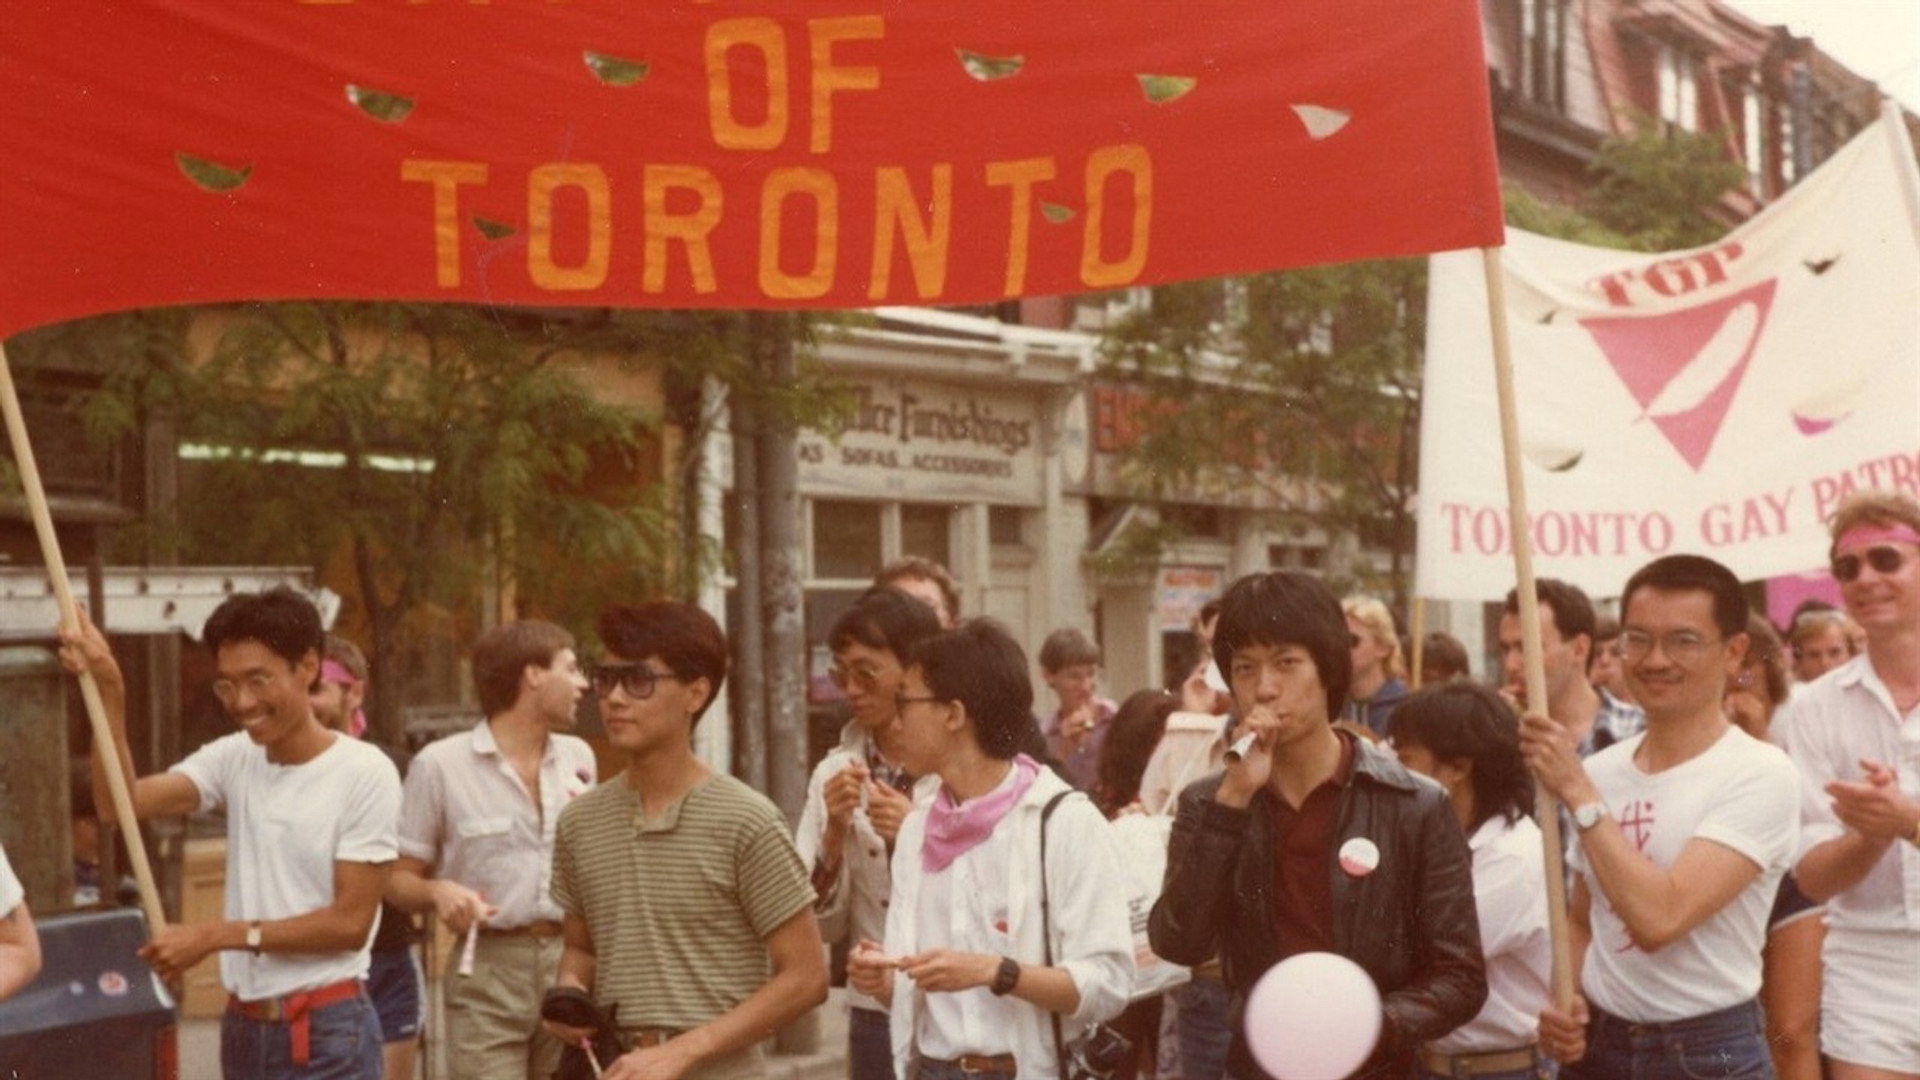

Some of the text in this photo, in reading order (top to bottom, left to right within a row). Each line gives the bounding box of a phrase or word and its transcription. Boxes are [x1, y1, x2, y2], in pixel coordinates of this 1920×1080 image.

[703, 16, 885, 153] OF
[401, 145, 1154, 300] TORONTO
[1586, 241, 1743, 307] TGP
[898, 393, 1030, 456] Furnishings
[1700, 486, 1797, 548] GAY
[1811, 449, 1920, 525] PATR
